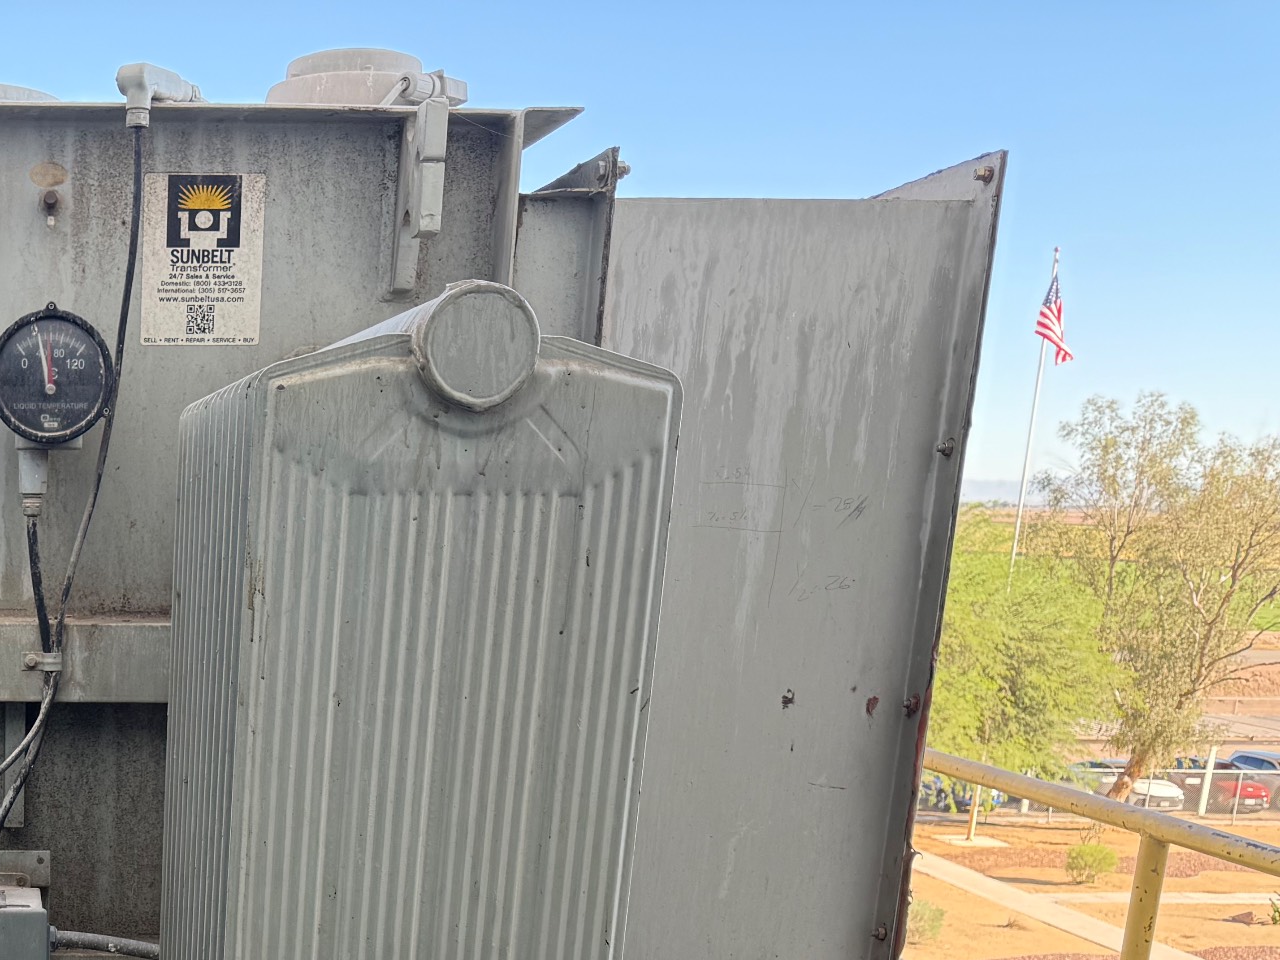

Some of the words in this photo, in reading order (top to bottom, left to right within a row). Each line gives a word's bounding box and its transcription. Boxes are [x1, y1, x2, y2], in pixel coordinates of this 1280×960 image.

[170, 249, 234, 264] SUNBELT
[170, 264, 233, 273] Transformer
[53, 348, 65, 358] 80
[21, 358, 28, 368] 0
[66, 358, 85, 369] 120
[39, 402, 89, 410] TEMPERATURE
